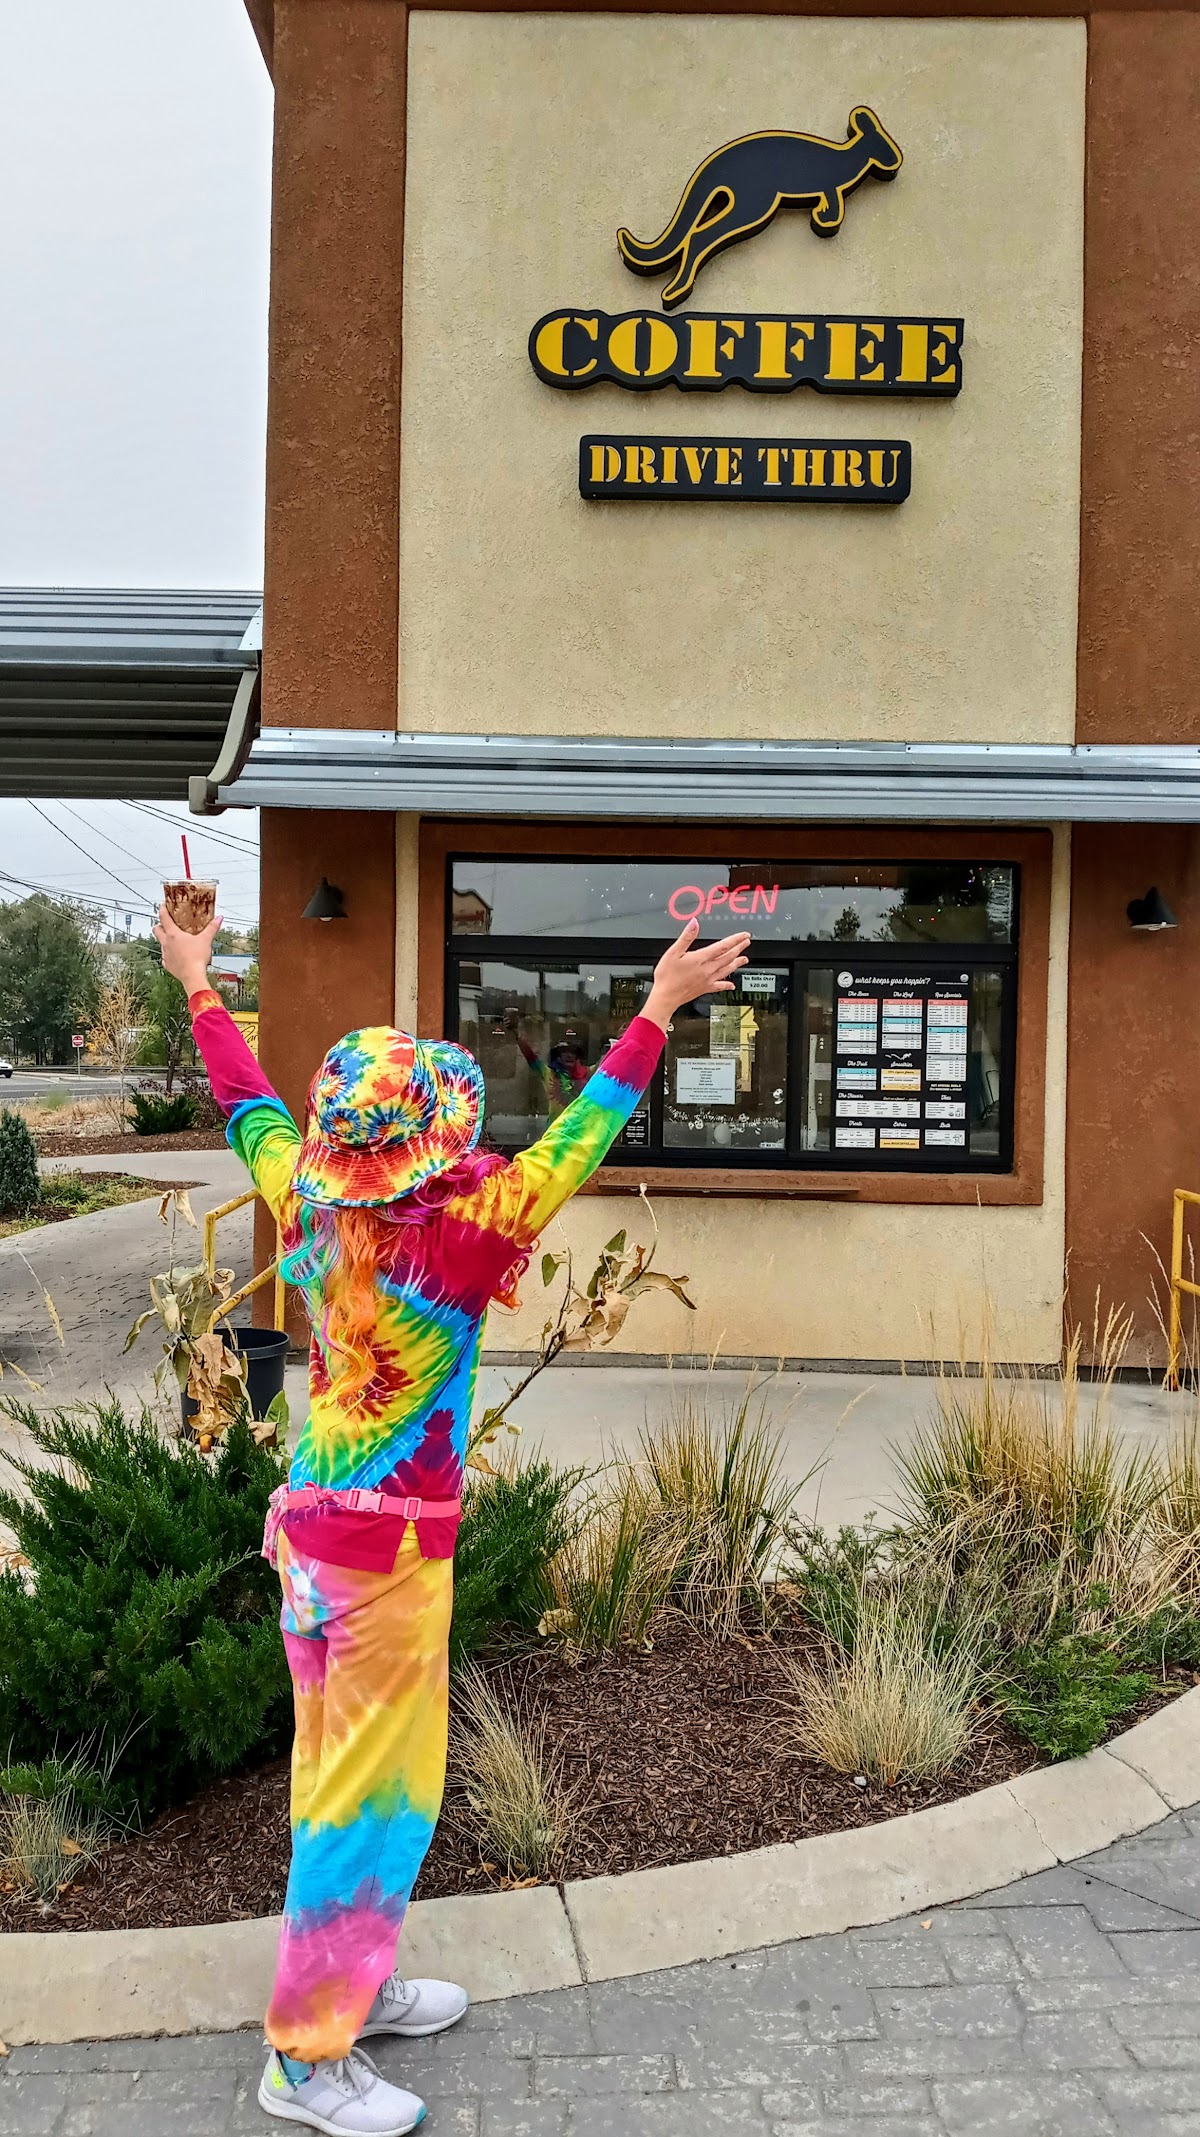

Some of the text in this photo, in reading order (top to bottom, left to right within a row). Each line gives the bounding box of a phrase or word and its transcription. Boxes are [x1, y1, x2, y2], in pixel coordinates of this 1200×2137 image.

[535, 316, 957, 383] COFFEE
[588, 444, 902, 488] DRIVE THRU
[668, 884, 780, 921] OPEN
[855, 976, 872, 984] what
[872, 976, 890, 986] keeps
[890, 978, 903, 986] you
